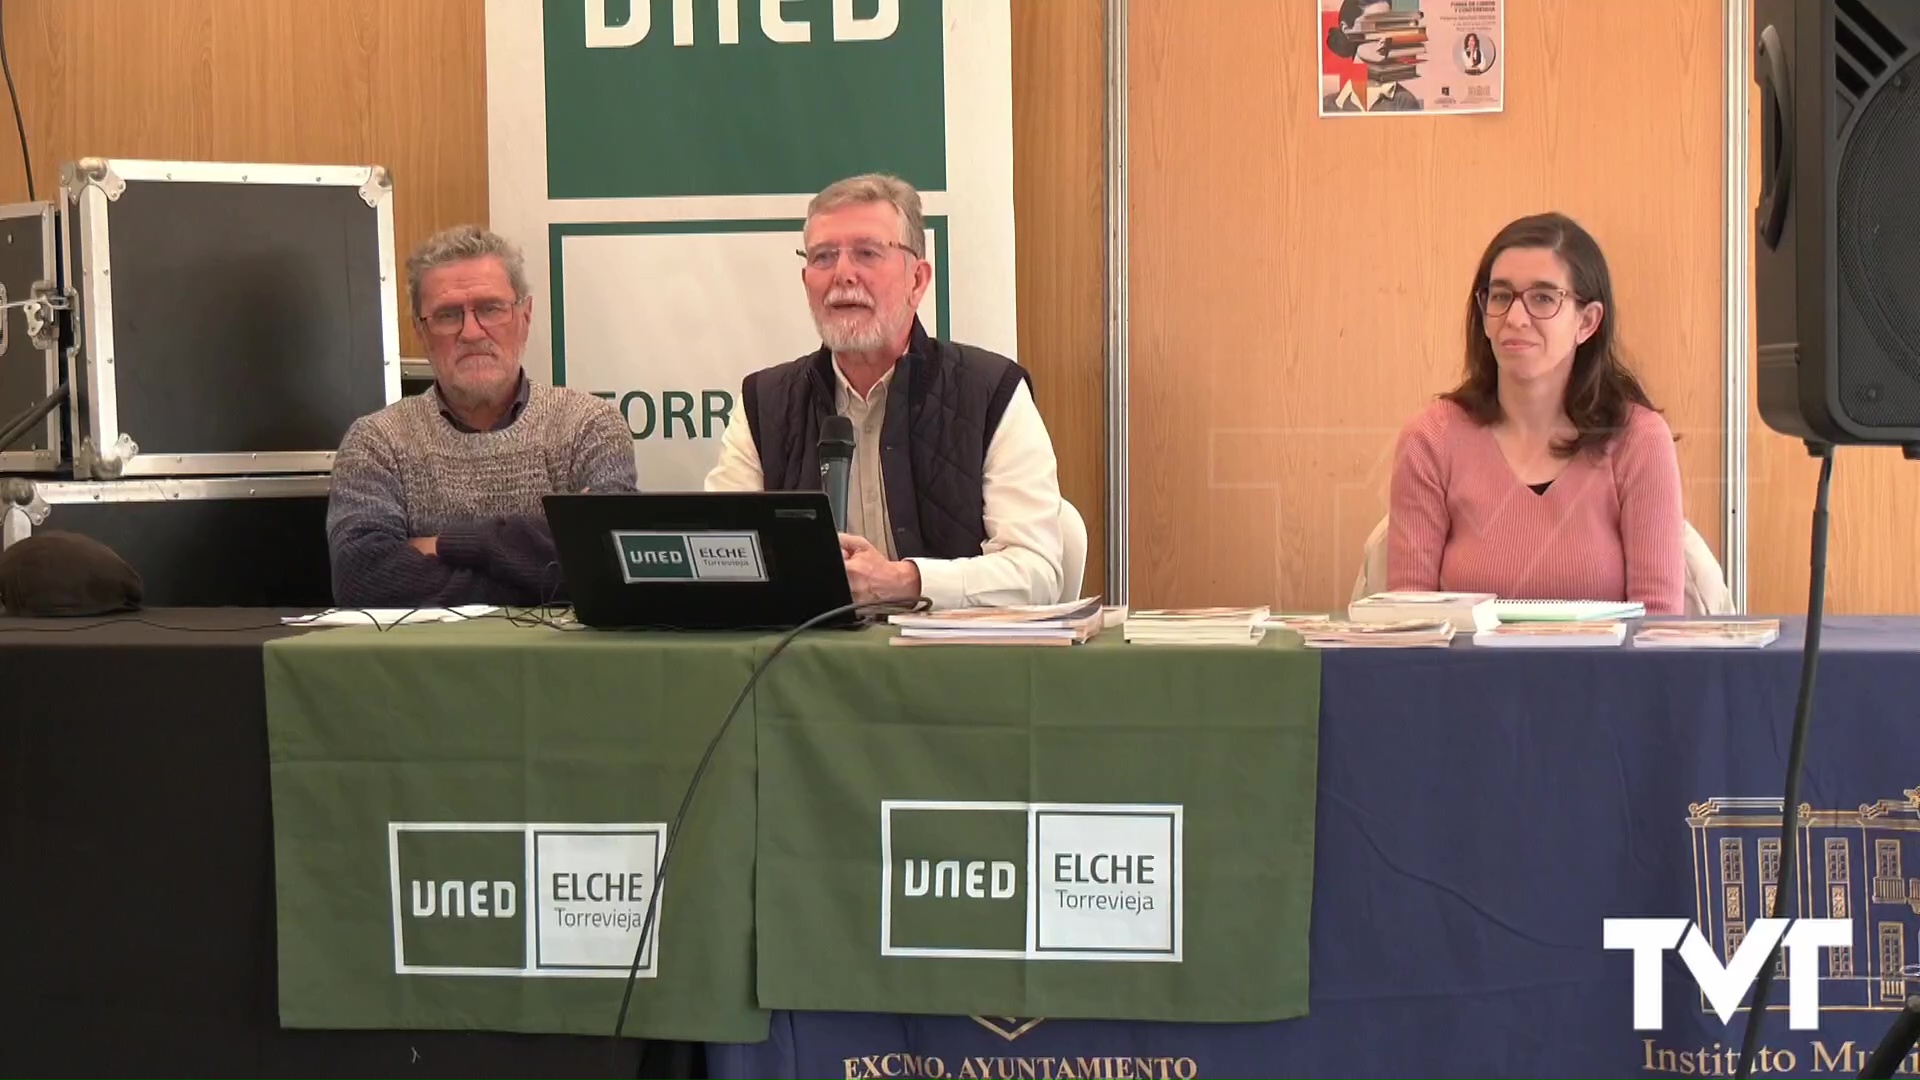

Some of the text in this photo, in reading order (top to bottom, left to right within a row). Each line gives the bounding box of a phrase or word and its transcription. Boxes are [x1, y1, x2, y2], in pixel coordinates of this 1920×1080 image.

[630, 550, 684, 564] UNED
[700, 547, 748, 558] ELCHE
[904, 858, 1016, 899] UNED
[1054, 853, 1155, 885] ELCHE
[412, 880, 517, 919] UNED
[552, 872, 643, 902] ELCHE
[1054, 889, 1155, 916] Torrevieja
[553, 907, 642, 932] Torrevieja
[843, 1053, 1198, 1080] EXCMO. AYUNTAMIENTO
